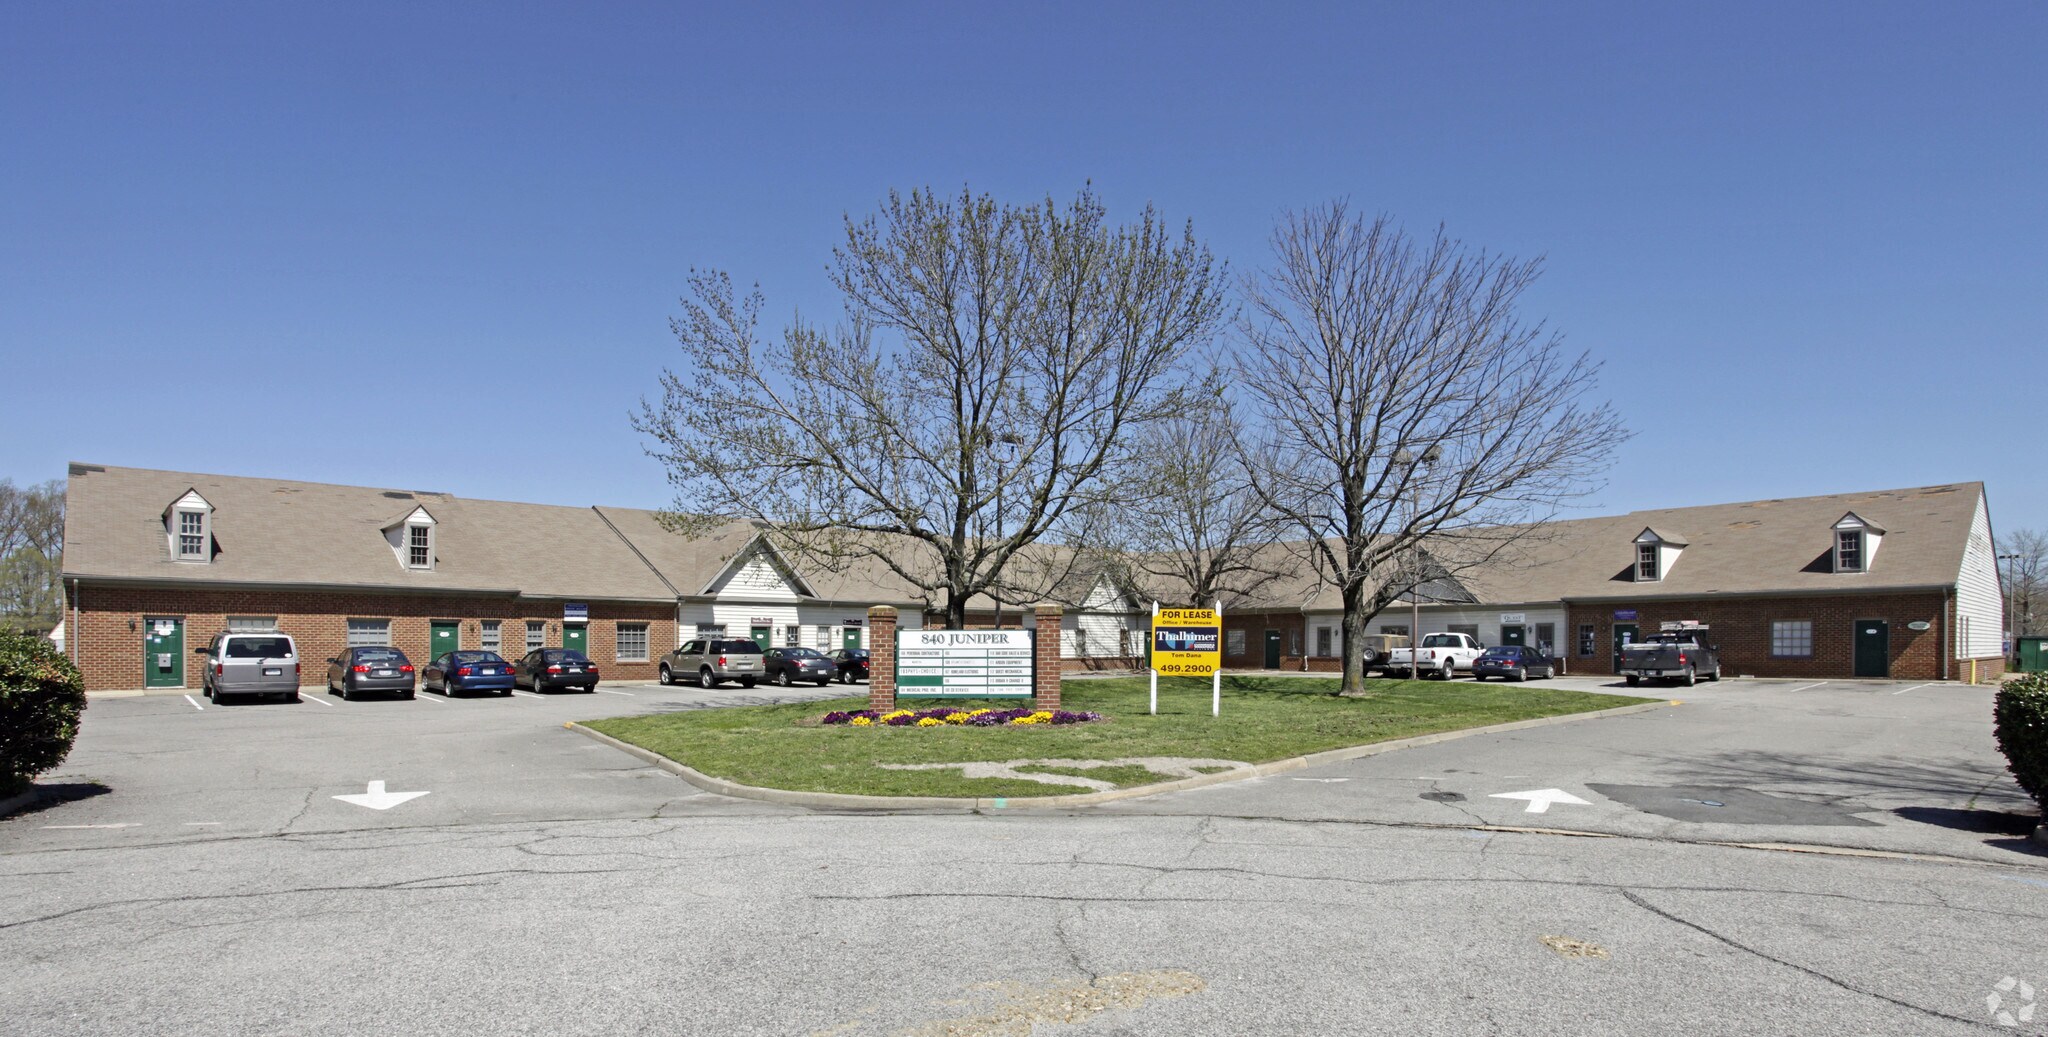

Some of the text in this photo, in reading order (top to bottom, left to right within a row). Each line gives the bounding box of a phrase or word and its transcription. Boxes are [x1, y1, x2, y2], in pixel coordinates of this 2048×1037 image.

[1162, 611, 1212, 619] FOR LEASE
[921, 633, 1010, 647] 840 JUNIPER
[1156, 631, 1217, 641] Thalhimer
[1160, 664, 1212, 673] 499.2900
